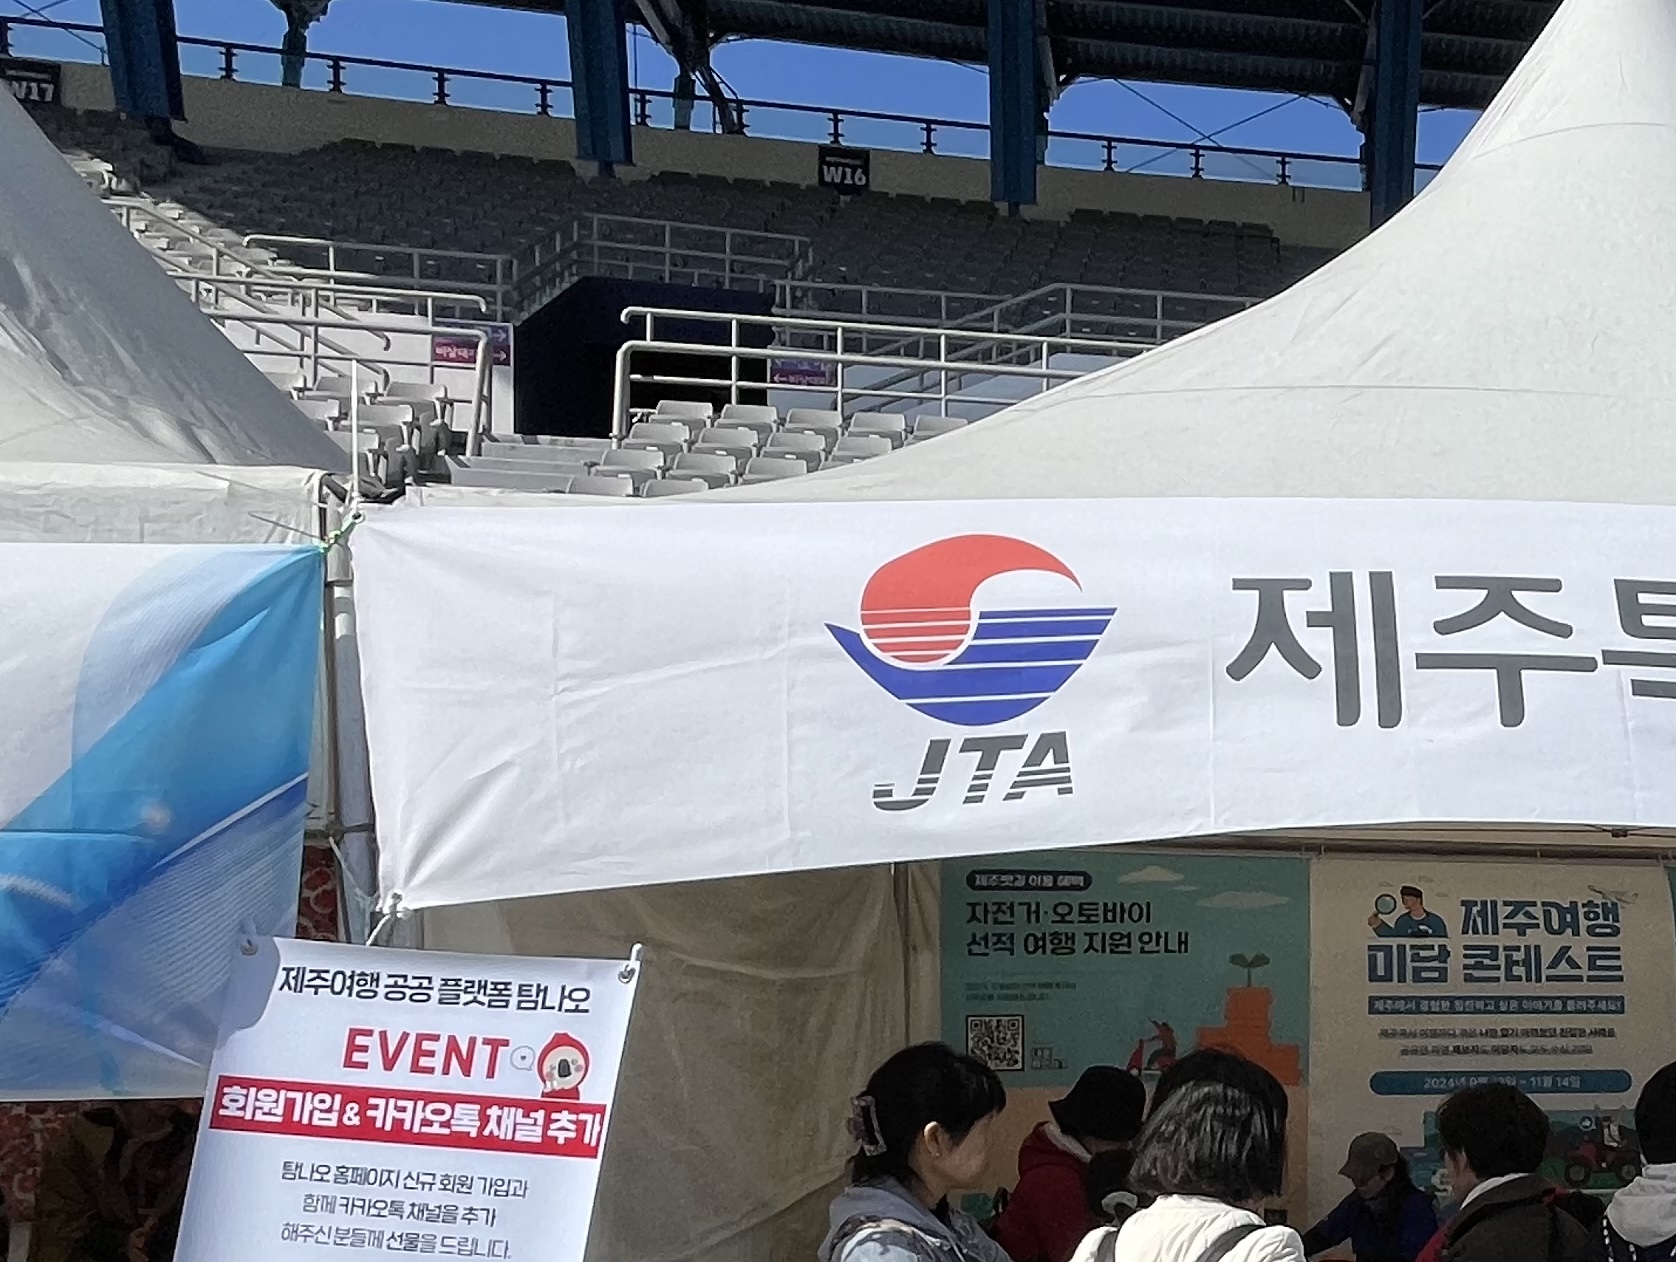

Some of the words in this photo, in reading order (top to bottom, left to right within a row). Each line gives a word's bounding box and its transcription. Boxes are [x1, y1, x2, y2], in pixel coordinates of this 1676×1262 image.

[822, 165, 866, 185] W16
[872, 730, 1074, 812] JTA
[1460, 899, 1623, 938] 제주여행
[966, 931, 1015, 957] 선적
[1024, 931, 1076, 956] 여행
[1083, 930, 1133, 955] 지원
[1138, 930, 1190, 955] 안내
[1367, 944, 1450, 984] 미담
[1462, 944, 1625, 984] 콘테스트
[278, 966, 381, 1000] 제주여행
[383, 972, 434, 1006] 공공
[437, 975, 514, 1011] 플랫폼
[516, 982, 592, 1015] 탐나오
[342, 1026, 511, 1080] EVENT
[219, 1085, 343, 1128] 회원가입
[366, 1096, 482, 1138] 카카오톡
[483, 1106, 545, 1144] 채널
[547, 1110, 601, 1149] 추가
[281, 1161, 332, 1184] 탐나오
[333, 1165, 400, 1191] 홈페이지
[402, 1170, 438, 1193] 신규
[439, 1173, 474, 1196] 회원
[477, 1175, 529, 1200] 가입과
[302, 1193, 335, 1216] 함께
[339, 1195, 405, 1222] 카카오톡
[407, 1200, 459, 1225] 채널을
[461, 1205, 498, 1229] 추가
[281, 1223, 332, 1246] 해주신
[333, 1225, 384, 1250] 분들께
[385, 1229, 438, 1255] 선물을
[439, 1233, 513, 1261] 드립니다.
